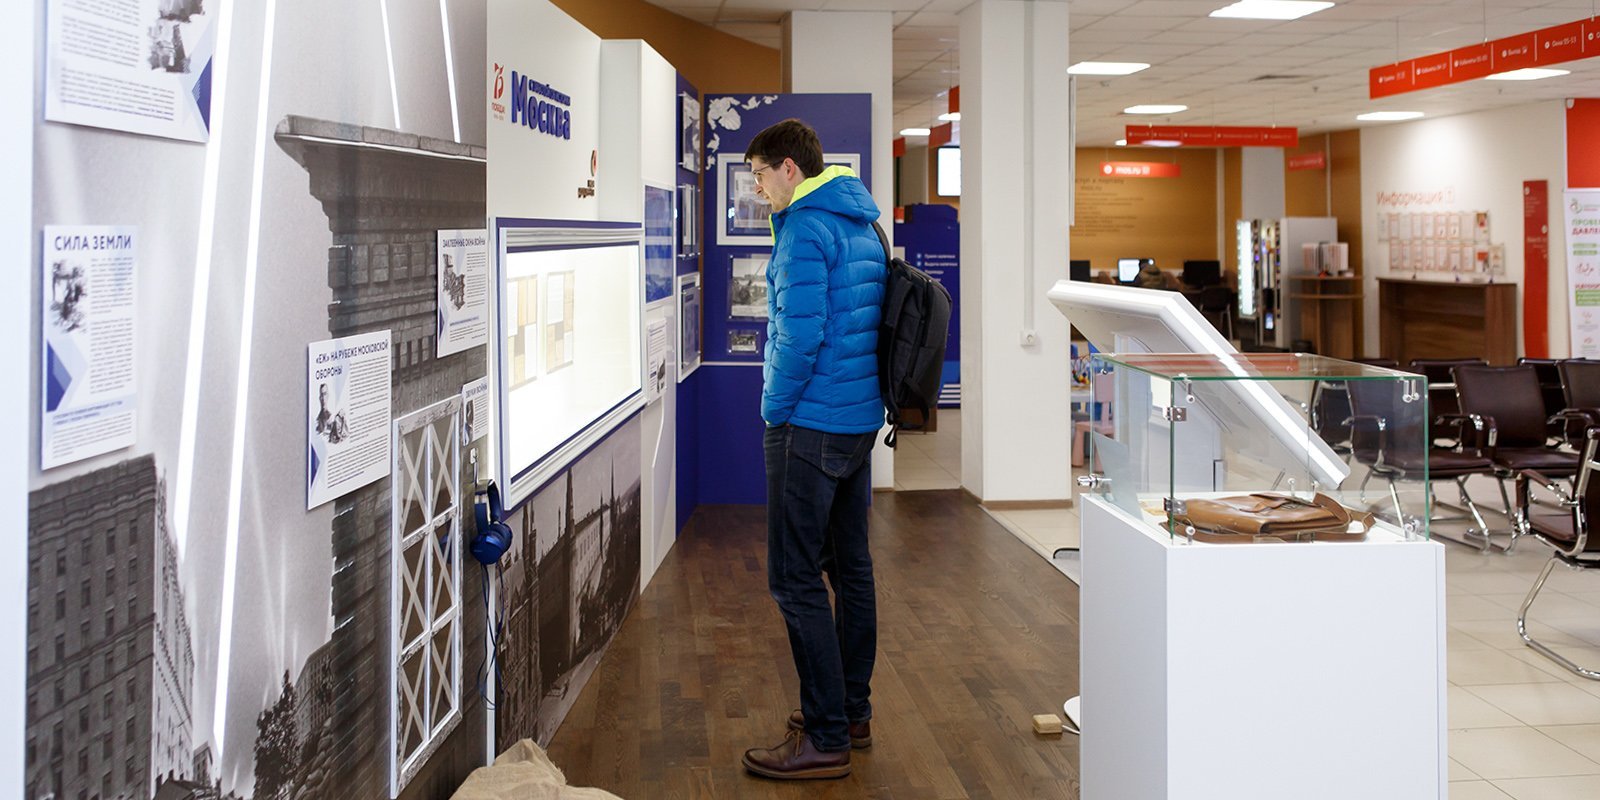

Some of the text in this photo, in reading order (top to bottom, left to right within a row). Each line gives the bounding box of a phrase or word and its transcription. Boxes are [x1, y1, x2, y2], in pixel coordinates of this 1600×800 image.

[511, 70, 571, 140] Москва
[1572, 218, 1600, 227] ПРОВЕ
[1572, 227, 1600, 236] ДАВЛЕ
[55, 235, 132, 251] СИЛА ЗЕМЛИ
[316, 338, 389, 364] «ЕЖ» НА РУБЕЖЕ МОСКОВСКОЙ
[315, 365, 343, 380] ОБОРОНЫ
